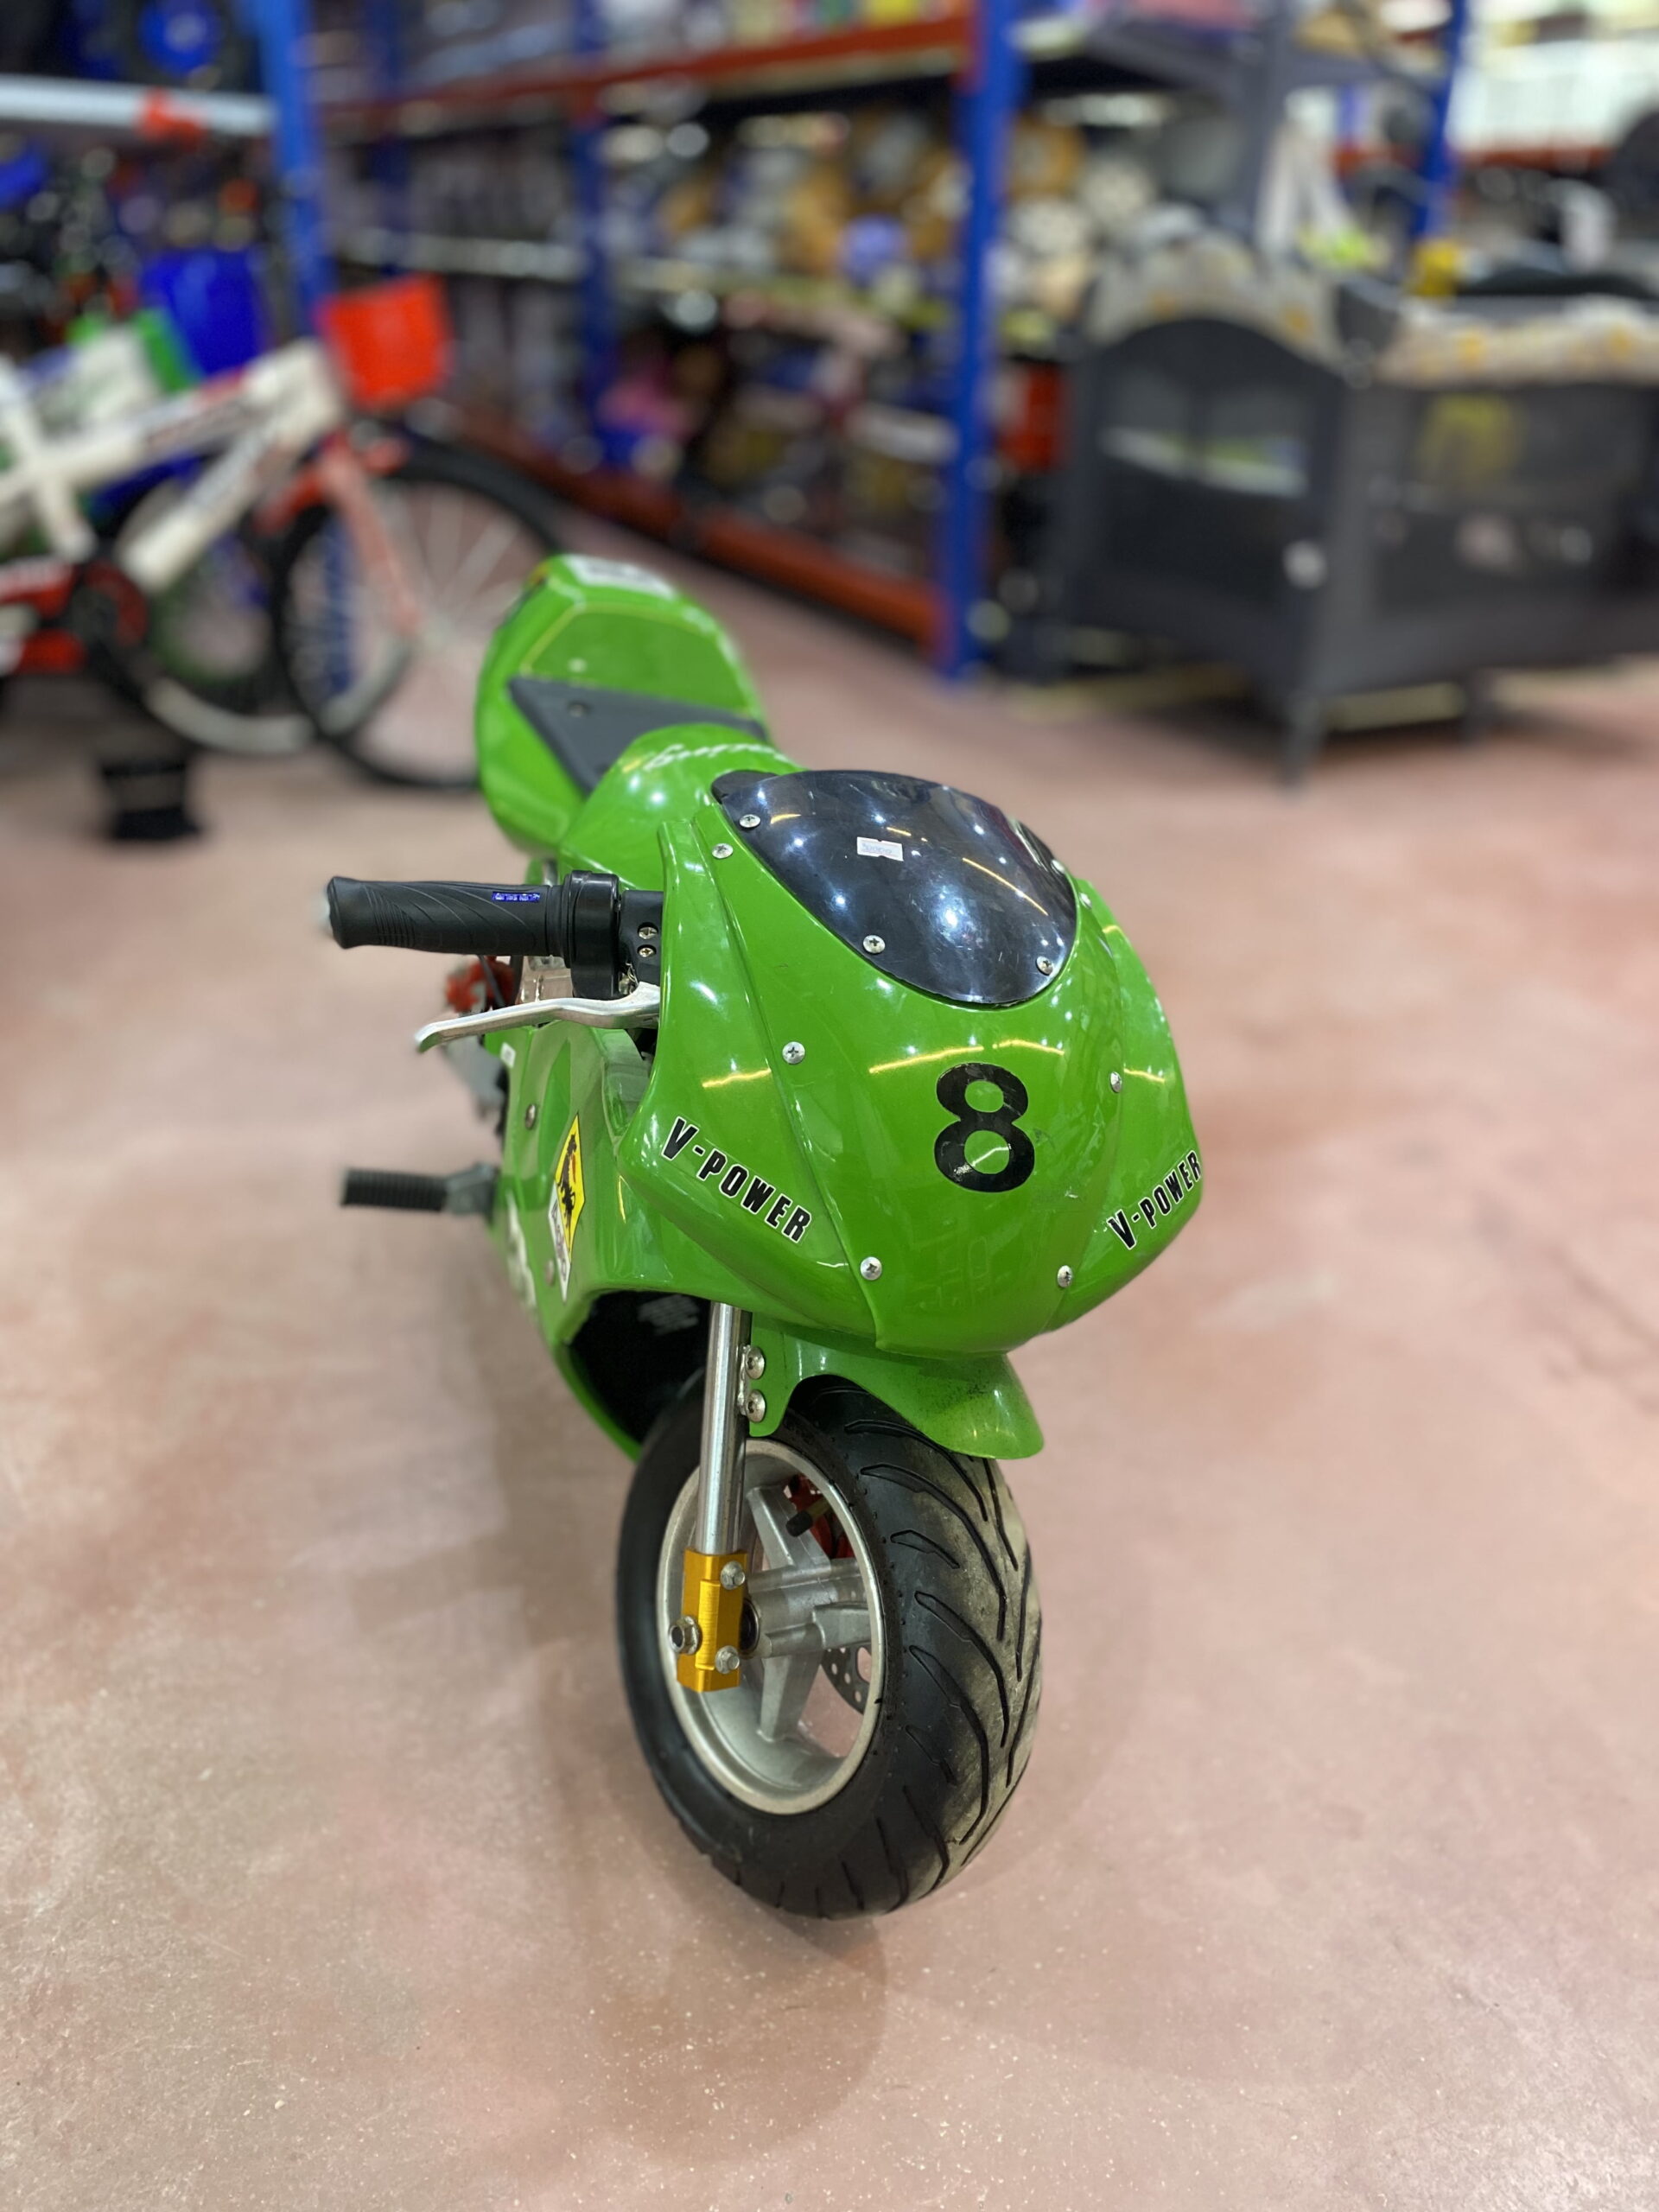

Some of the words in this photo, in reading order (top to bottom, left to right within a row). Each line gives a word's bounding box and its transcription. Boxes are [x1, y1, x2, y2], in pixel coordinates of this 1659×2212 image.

[661, 1116, 812, 1244] V-POWER
[934, 1062, 1035, 1193] 8
[1106, 1150, 1202, 1250] V-POWER
